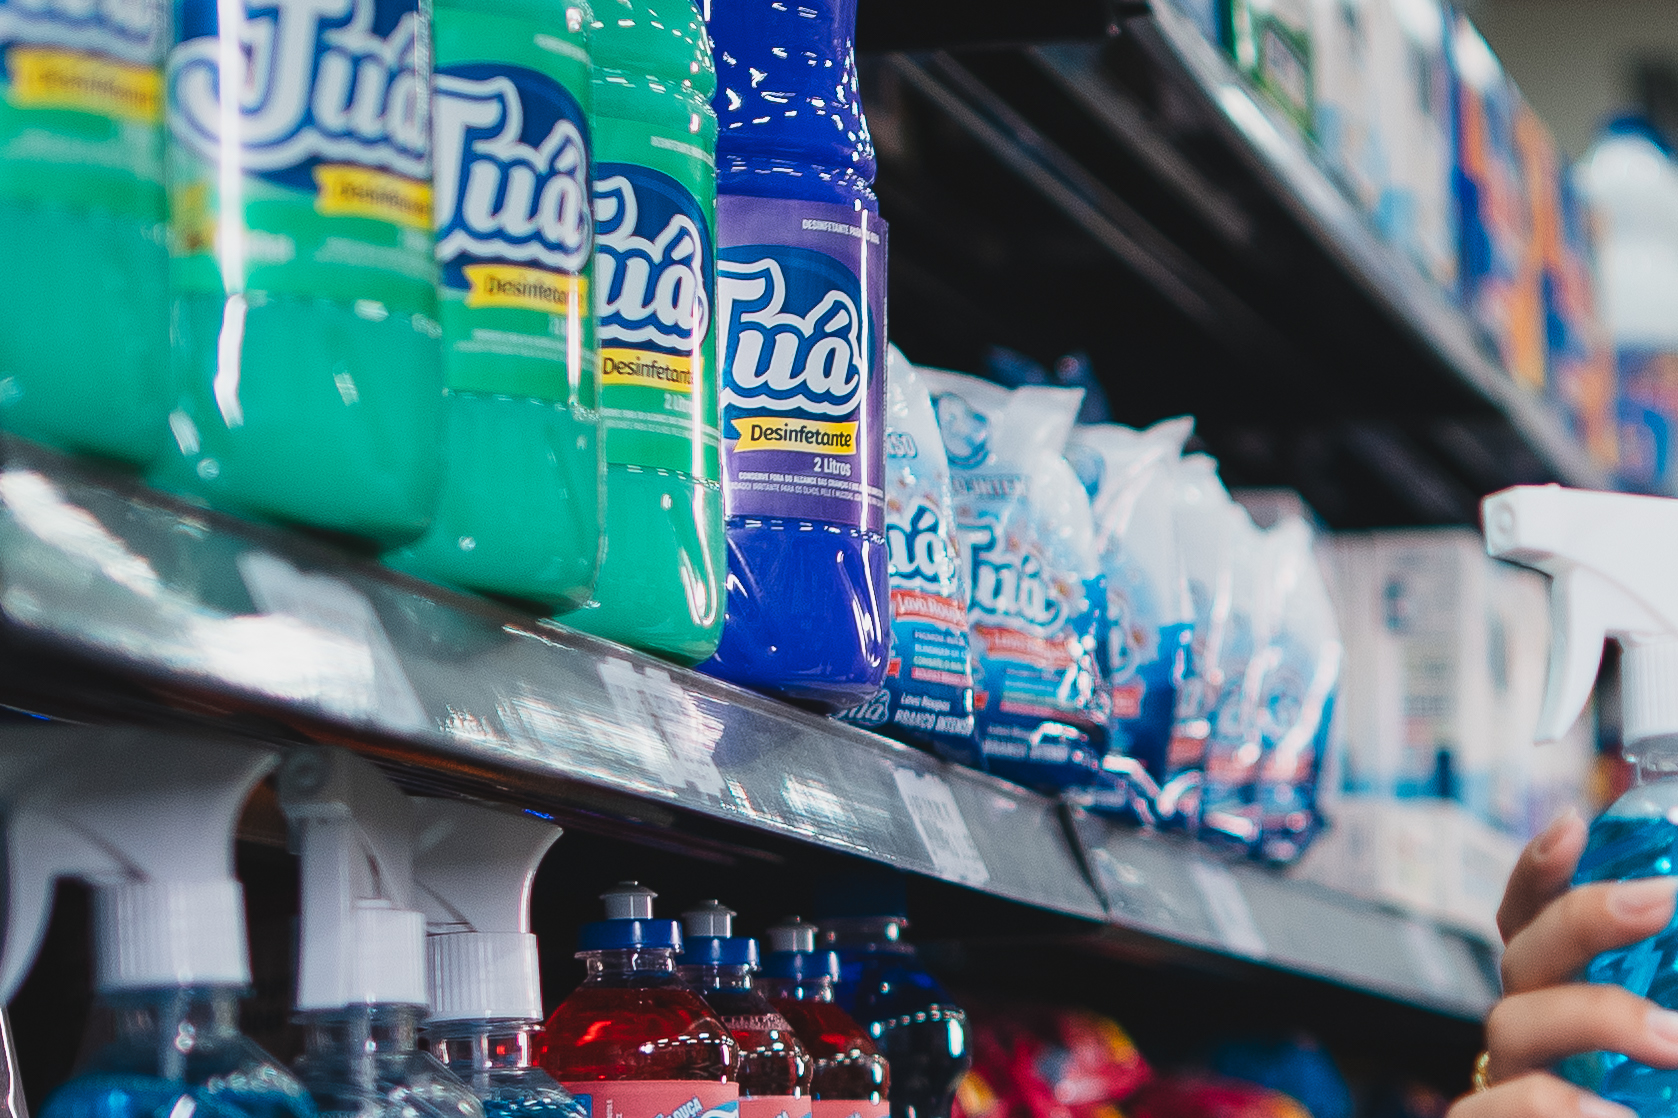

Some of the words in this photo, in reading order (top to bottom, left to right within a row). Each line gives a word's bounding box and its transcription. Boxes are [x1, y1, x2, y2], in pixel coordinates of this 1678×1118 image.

[596, 186, 703, 341] uá
[602, 356, 696, 385] Desinfetant
[750, 422, 852, 448] Desinfetante
[813, 457, 822, 472] 2
[824, 458, 852, 476] Litros
